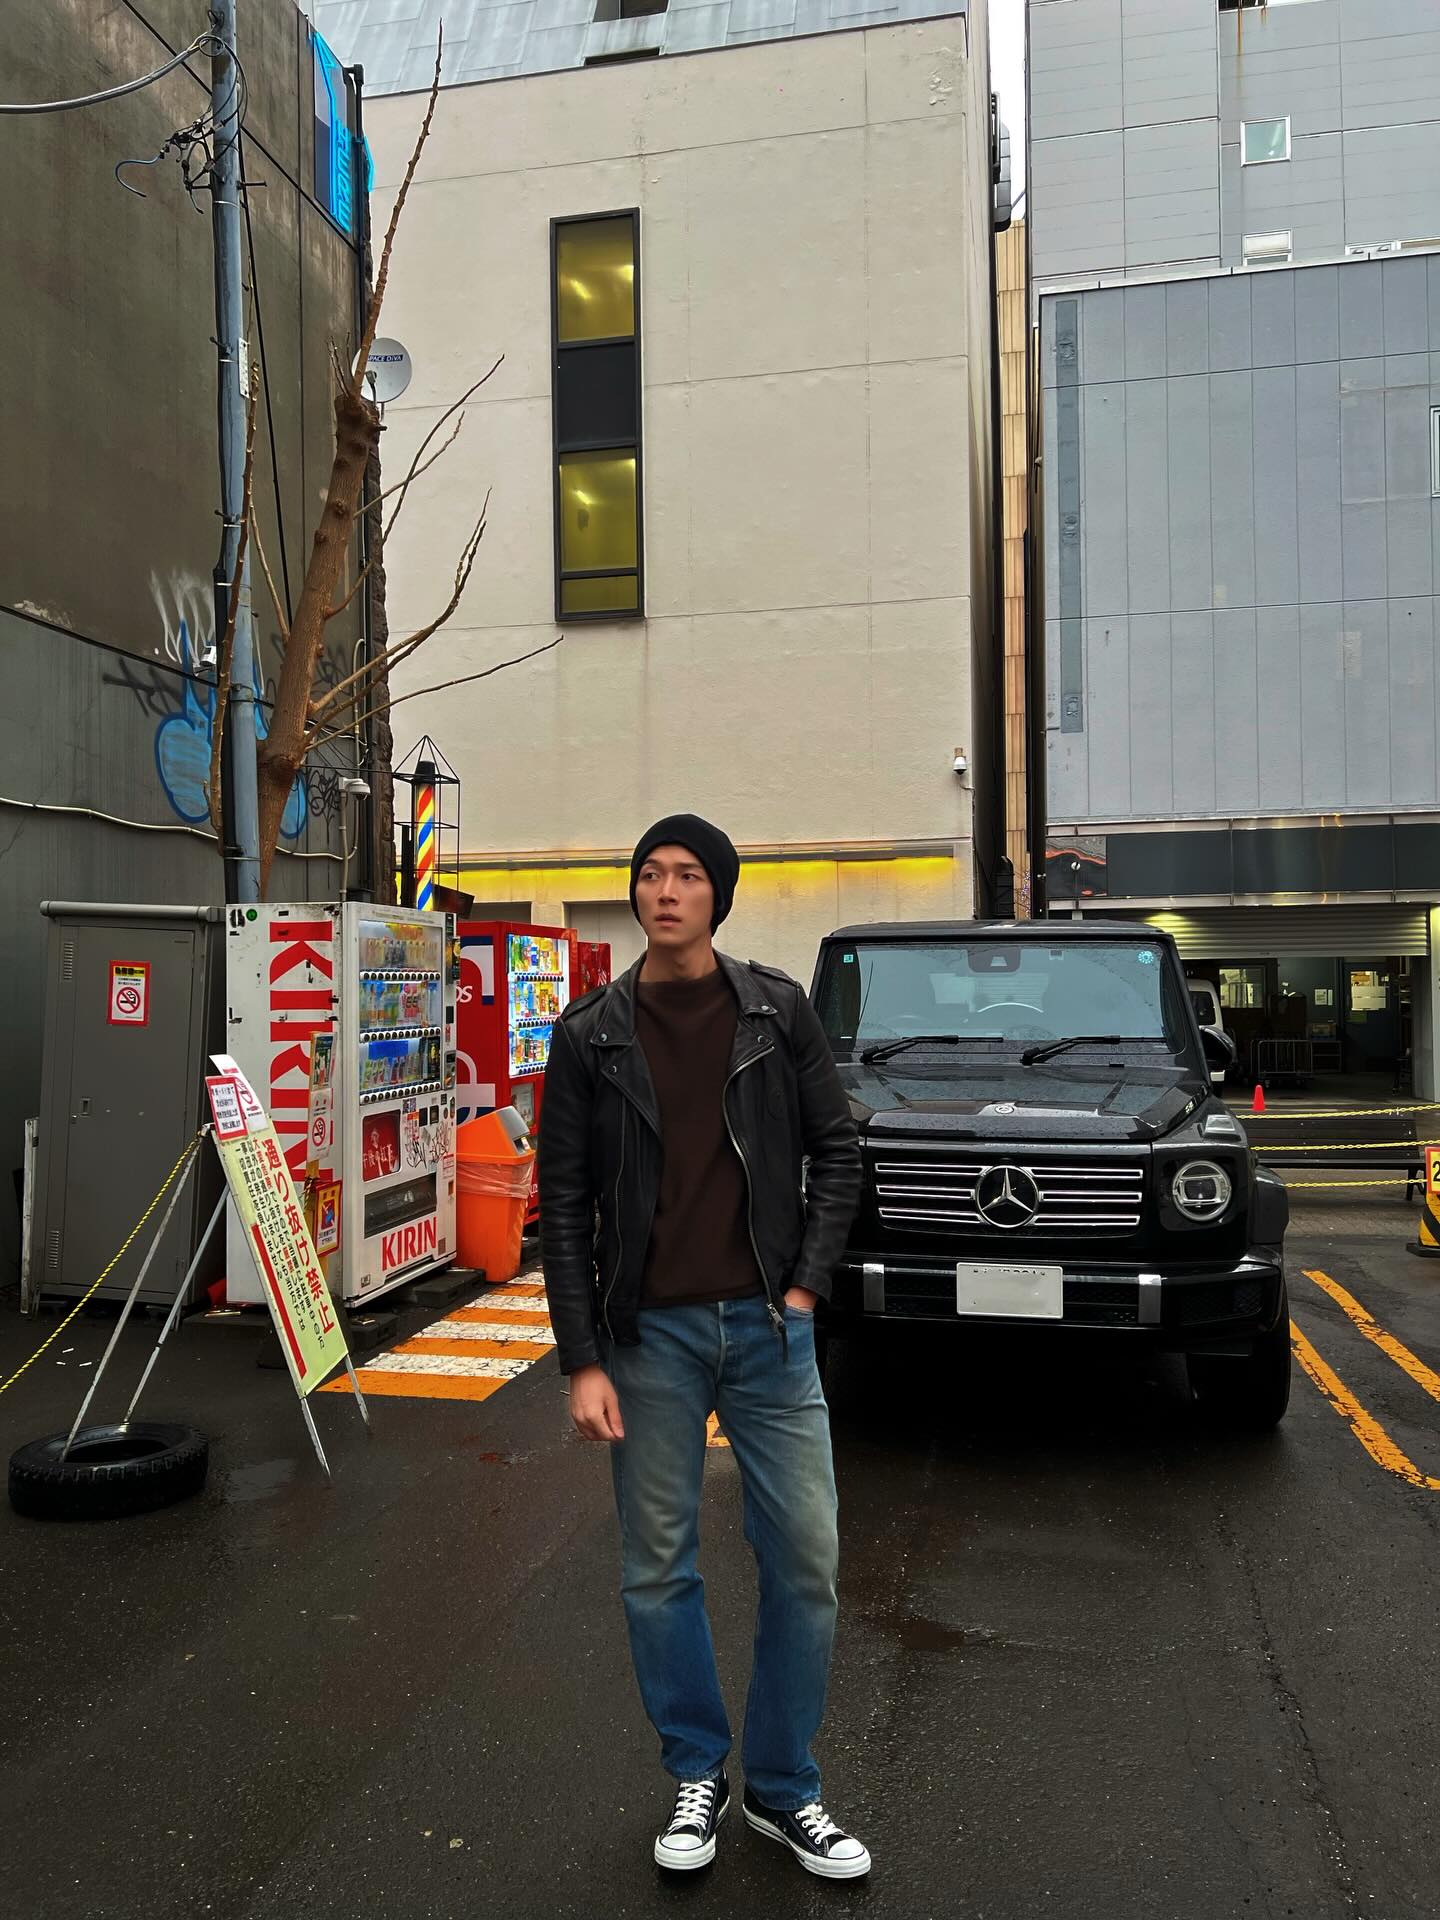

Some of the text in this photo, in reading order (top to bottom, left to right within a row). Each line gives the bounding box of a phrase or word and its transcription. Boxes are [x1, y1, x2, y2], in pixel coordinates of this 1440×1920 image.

[269, 920, 334, 1182] KIRIN
[260, 1136, 335, 1336] 通り抜け禁止
[382, 1216, 438, 1272] KIRIN
